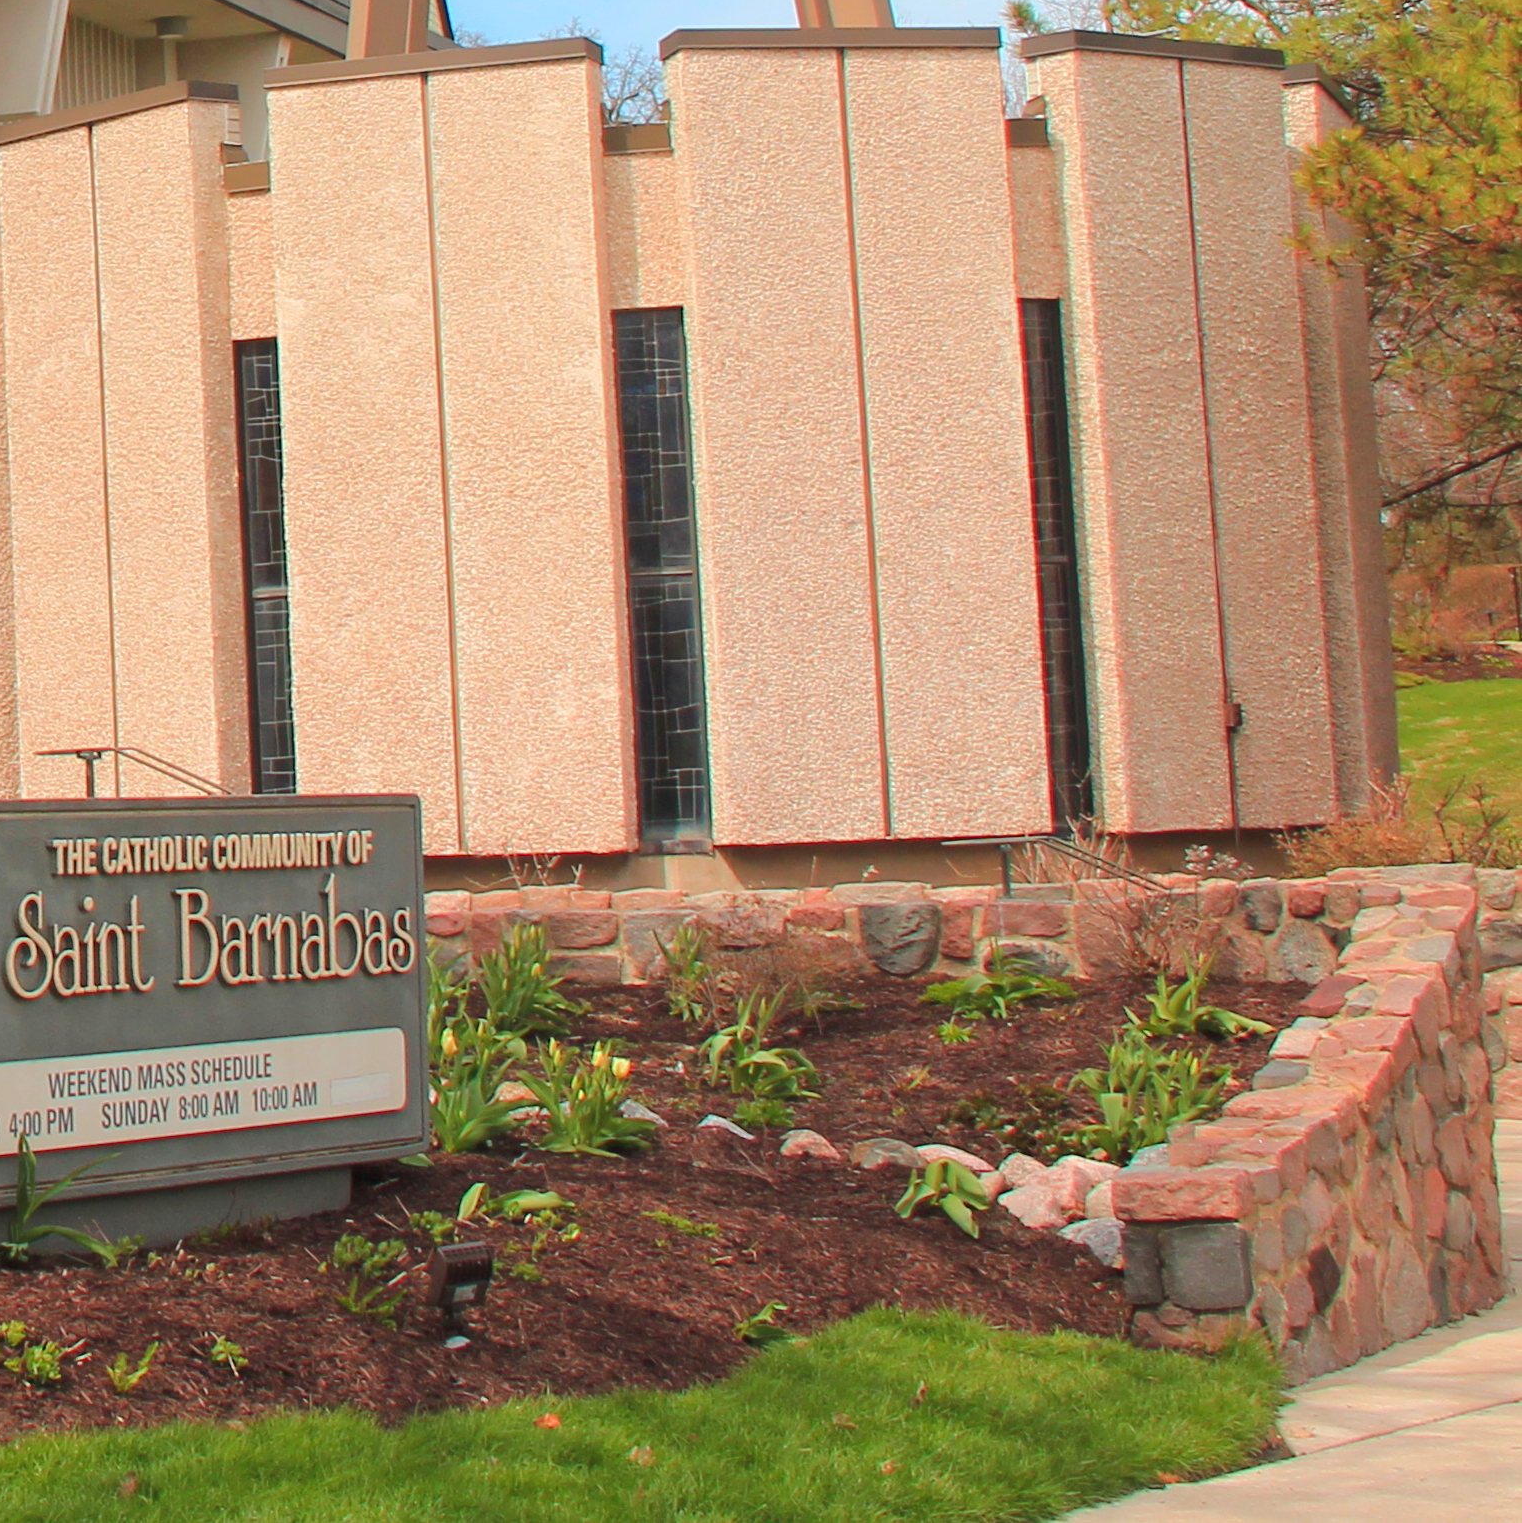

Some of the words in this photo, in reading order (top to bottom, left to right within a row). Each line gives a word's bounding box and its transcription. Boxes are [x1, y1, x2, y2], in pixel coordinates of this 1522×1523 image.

[52, 838, 98, 875] THE
[103, 835, 209, 873] CATHOLIC
[213, 832, 345, 869] COMMUNITY
[347, 830, 374, 864] OF
[5, 890, 155, 999] Saint
[174, 872, 417, 986] Barnabas
[48, 1066, 132, 1099] WEEKEND
[138, 1061, 186, 1090] MASS
[191, 1053, 273, 1085] SCHEDULE
[47, 1107, 74, 1134] PM
[101, 1096, 170, 1129] SUNDAY
[179, 1093, 209, 1120] 8:00
[213, 1089, 239, 1116] AM
[252, 1085, 288, 1112] 10:00
[292, 1081, 317, 1108] AM
